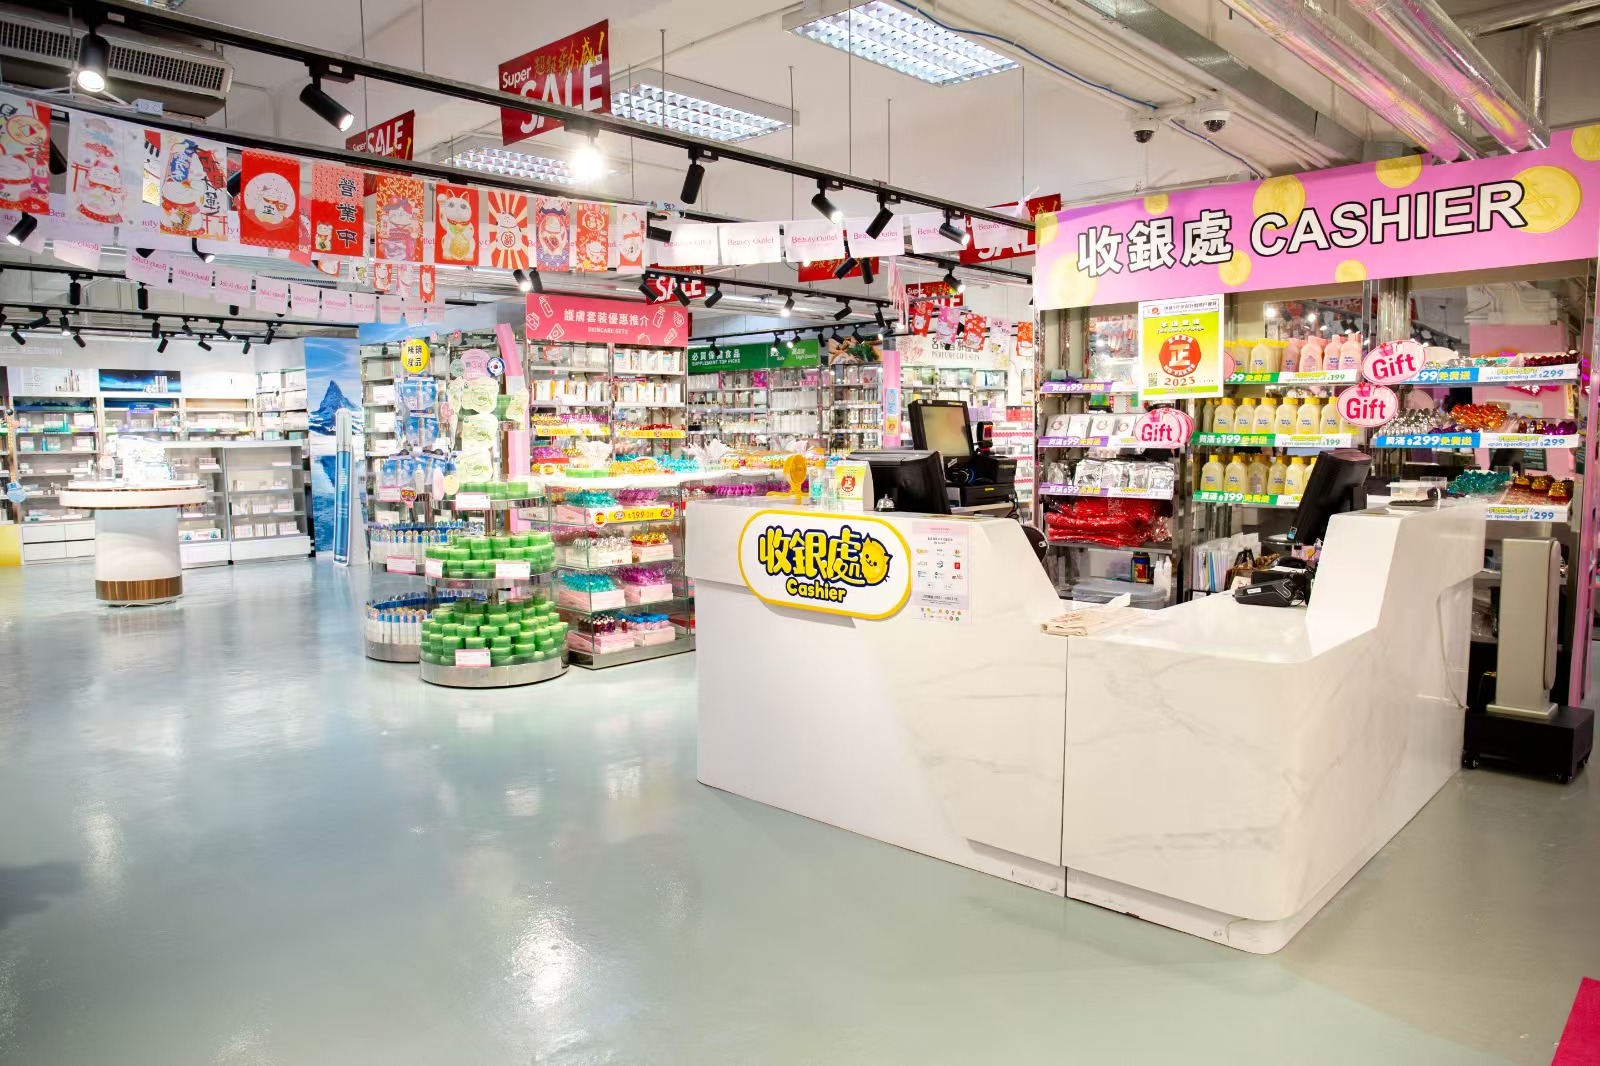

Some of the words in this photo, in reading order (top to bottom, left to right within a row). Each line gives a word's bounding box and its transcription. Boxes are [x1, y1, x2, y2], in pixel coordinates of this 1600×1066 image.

[502, 67, 531, 89] Super
[520, 54, 603, 133] SALE
[367, 119, 404, 156] SALE
[1076, 209, 1233, 279] 收銀處
[1249, 179, 1527, 257] CASHIER
[1372, 355, 1418, 379] Gift
[1163, 376, 1196, 387] 2023
[1346, 398, 1387, 420] Gift
[1140, 423, 1173, 443] Gift
[1406, 435, 1440, 446] $299
[1540, 438, 1565, 447] $299
[1529, 511, 1555, 520] $299
[758, 524, 866, 587] 收銀處
[785, 577, 847, 604] Cashier
